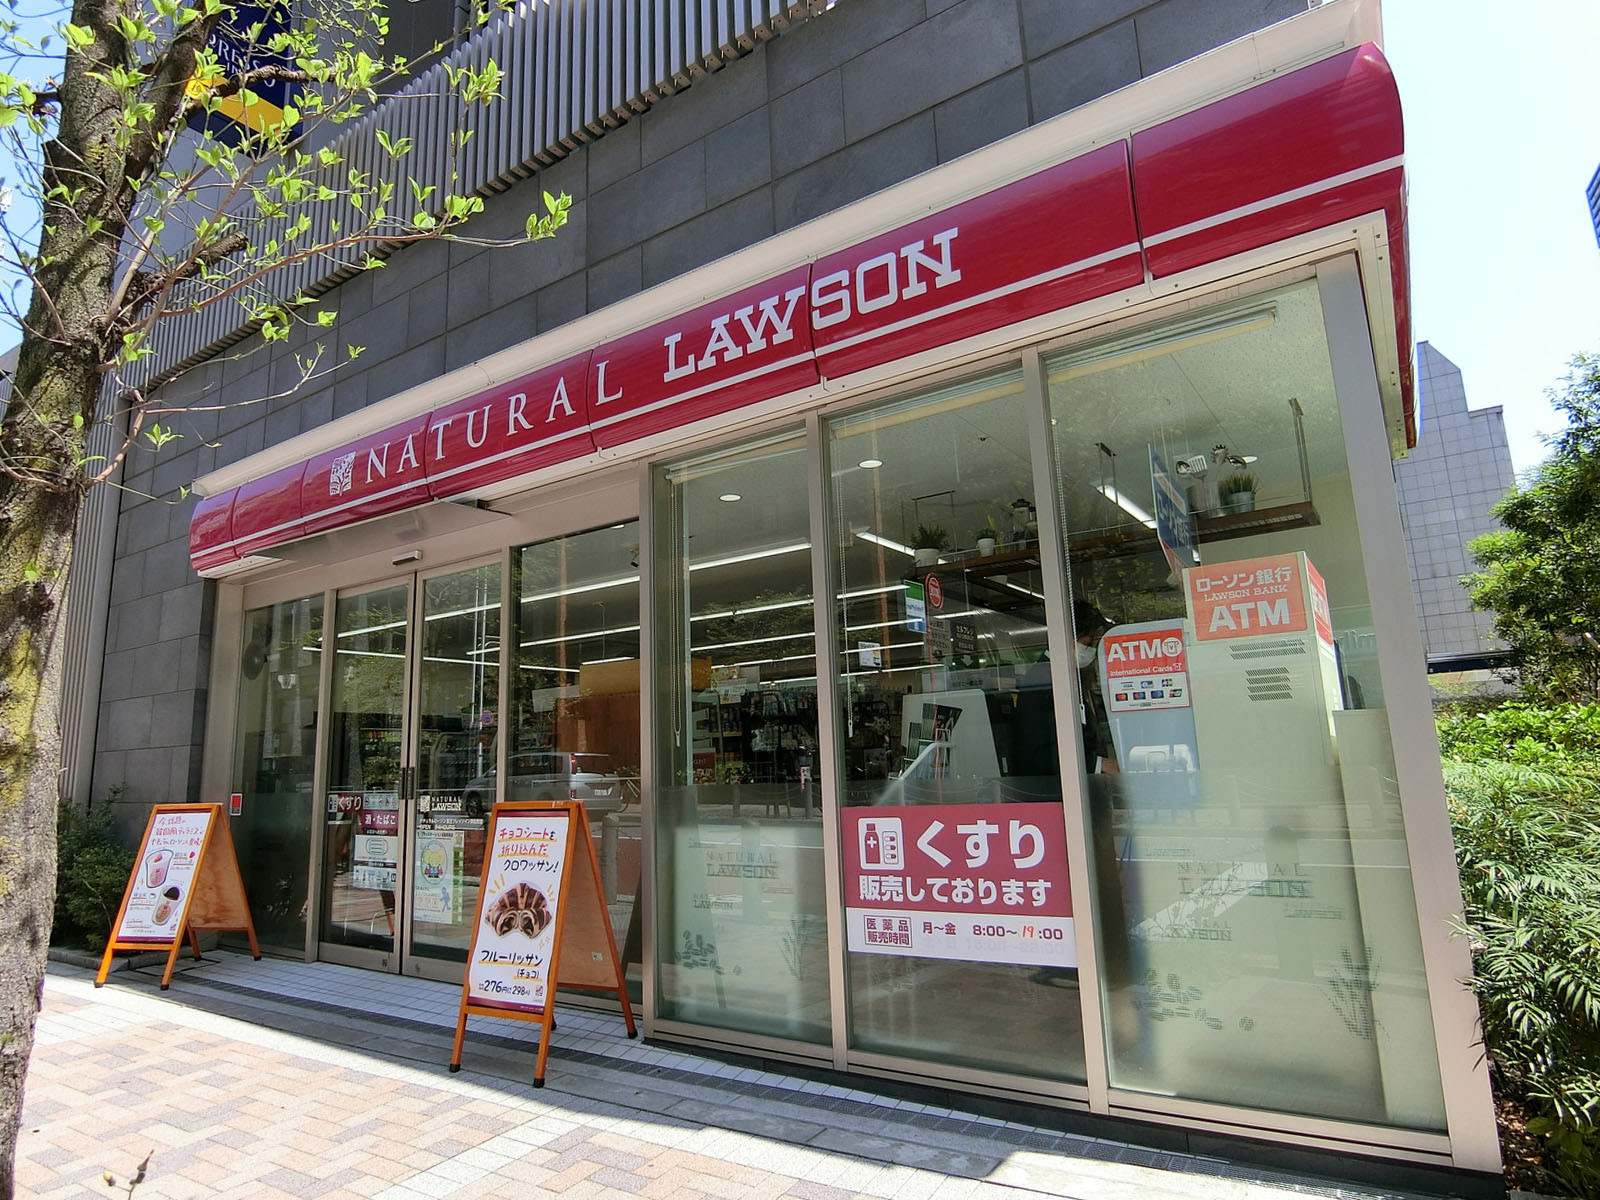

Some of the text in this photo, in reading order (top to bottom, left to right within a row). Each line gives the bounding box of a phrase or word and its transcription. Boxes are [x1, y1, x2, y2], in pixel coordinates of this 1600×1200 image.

[365, 227, 963, 484] NATURAL LAWSON
[1196, 566, 1292, 592] ローソン銀行
[1204, 584, 1288, 602] LAWSON BANK
[1209, 598, 1290, 632] ATM
[1107, 638, 1162, 663] ATM
[1110, 664, 1173, 676] International Cards
[339, 796, 362, 810] くすり
[431, 802, 462, 811] LAWSON
[499, 827, 556, 840] チョコシートを
[501, 843, 548, 856] 折り込んだ
[916, 819, 1045, 869] くすり
[504, 859, 559, 873] クロワッサン!
[859, 875, 1052, 907] 販売しております
[867, 931, 910, 945] 販売時間
[481, 950, 543, 967] フルーリッサン
[517, 968, 540, 979] (チョコ)
